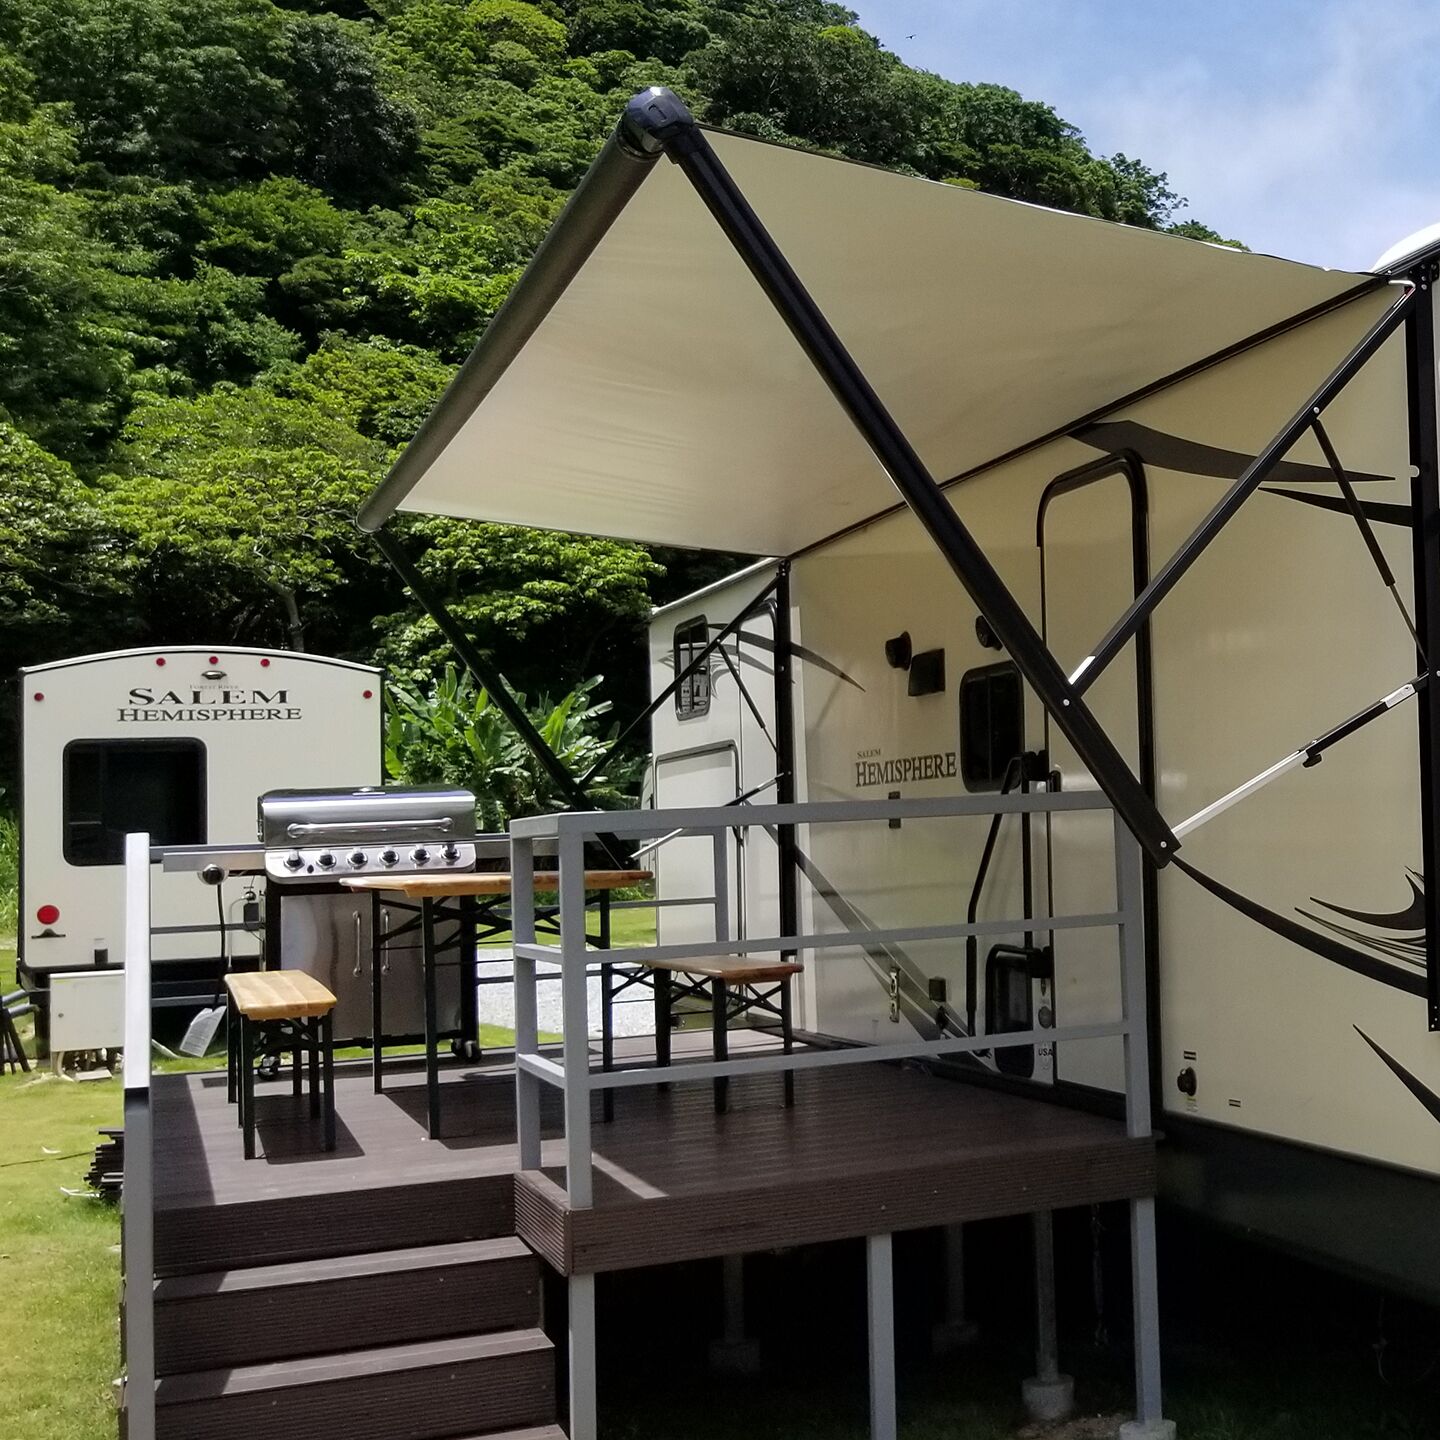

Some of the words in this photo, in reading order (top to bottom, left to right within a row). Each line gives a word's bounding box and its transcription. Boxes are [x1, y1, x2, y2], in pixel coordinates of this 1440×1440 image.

[128, 687, 290, 706] SALEM
[116, 707, 303, 722] HEMISPHERE
[857, 748, 881, 760] SALEM
[855, 752, 957, 788] HEMISPHERE
